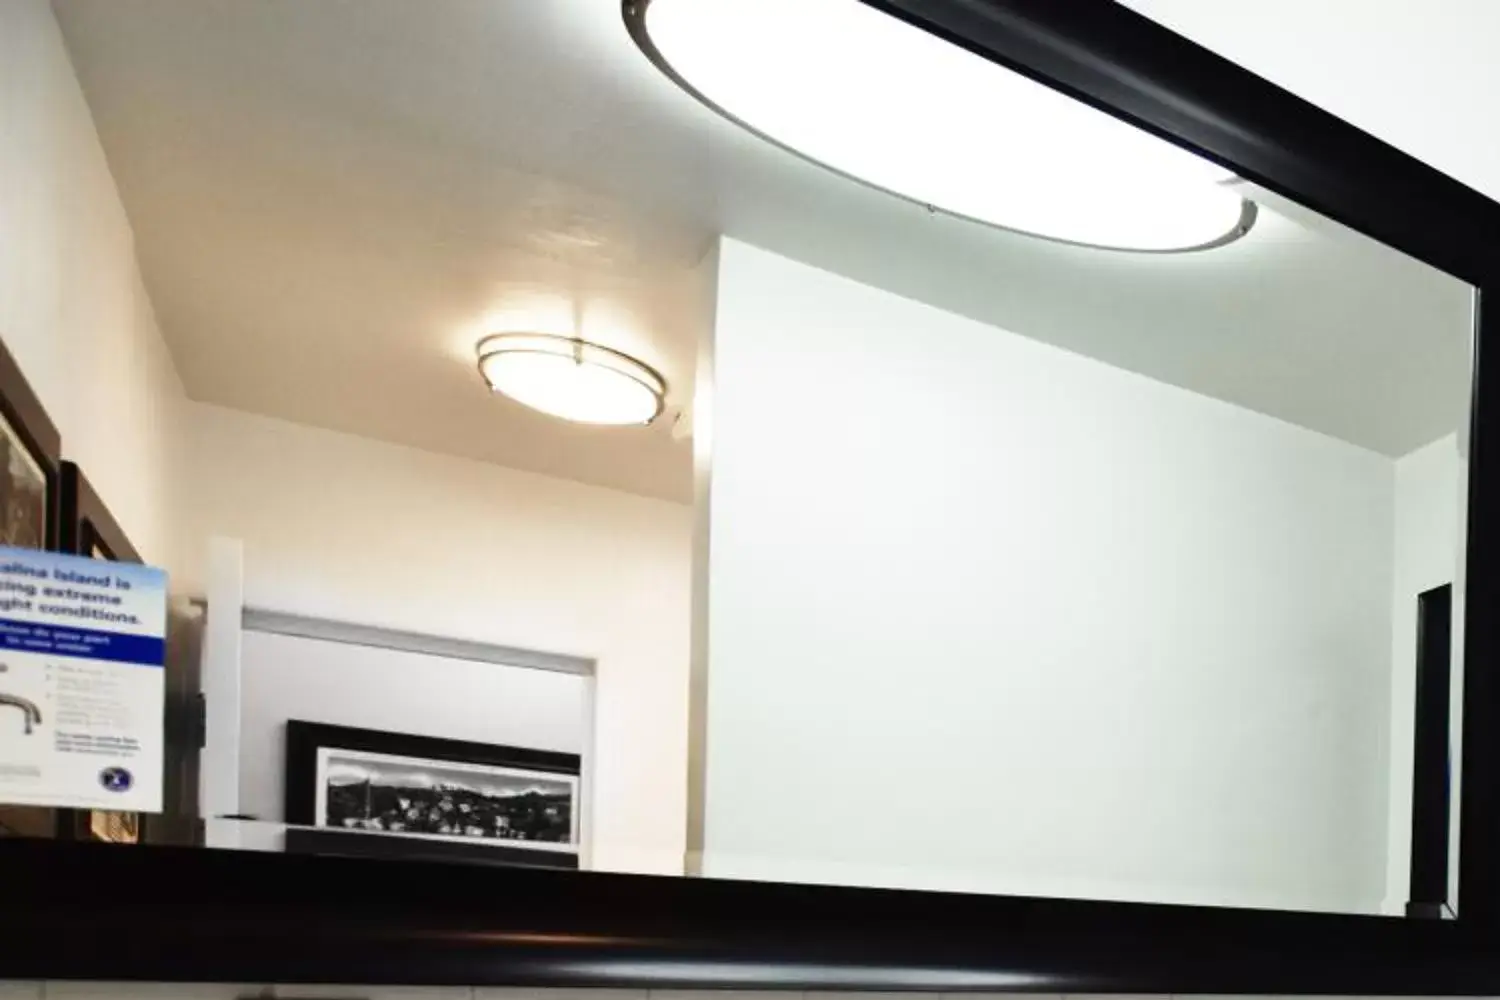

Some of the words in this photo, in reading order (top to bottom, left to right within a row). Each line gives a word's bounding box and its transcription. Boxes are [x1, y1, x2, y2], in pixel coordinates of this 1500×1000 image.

[54, 568, 111, 588] Island
[116, 576, 132, 590] is
[43, 587, 122, 605] extreme
[38, 603, 143, 625] conditions.
